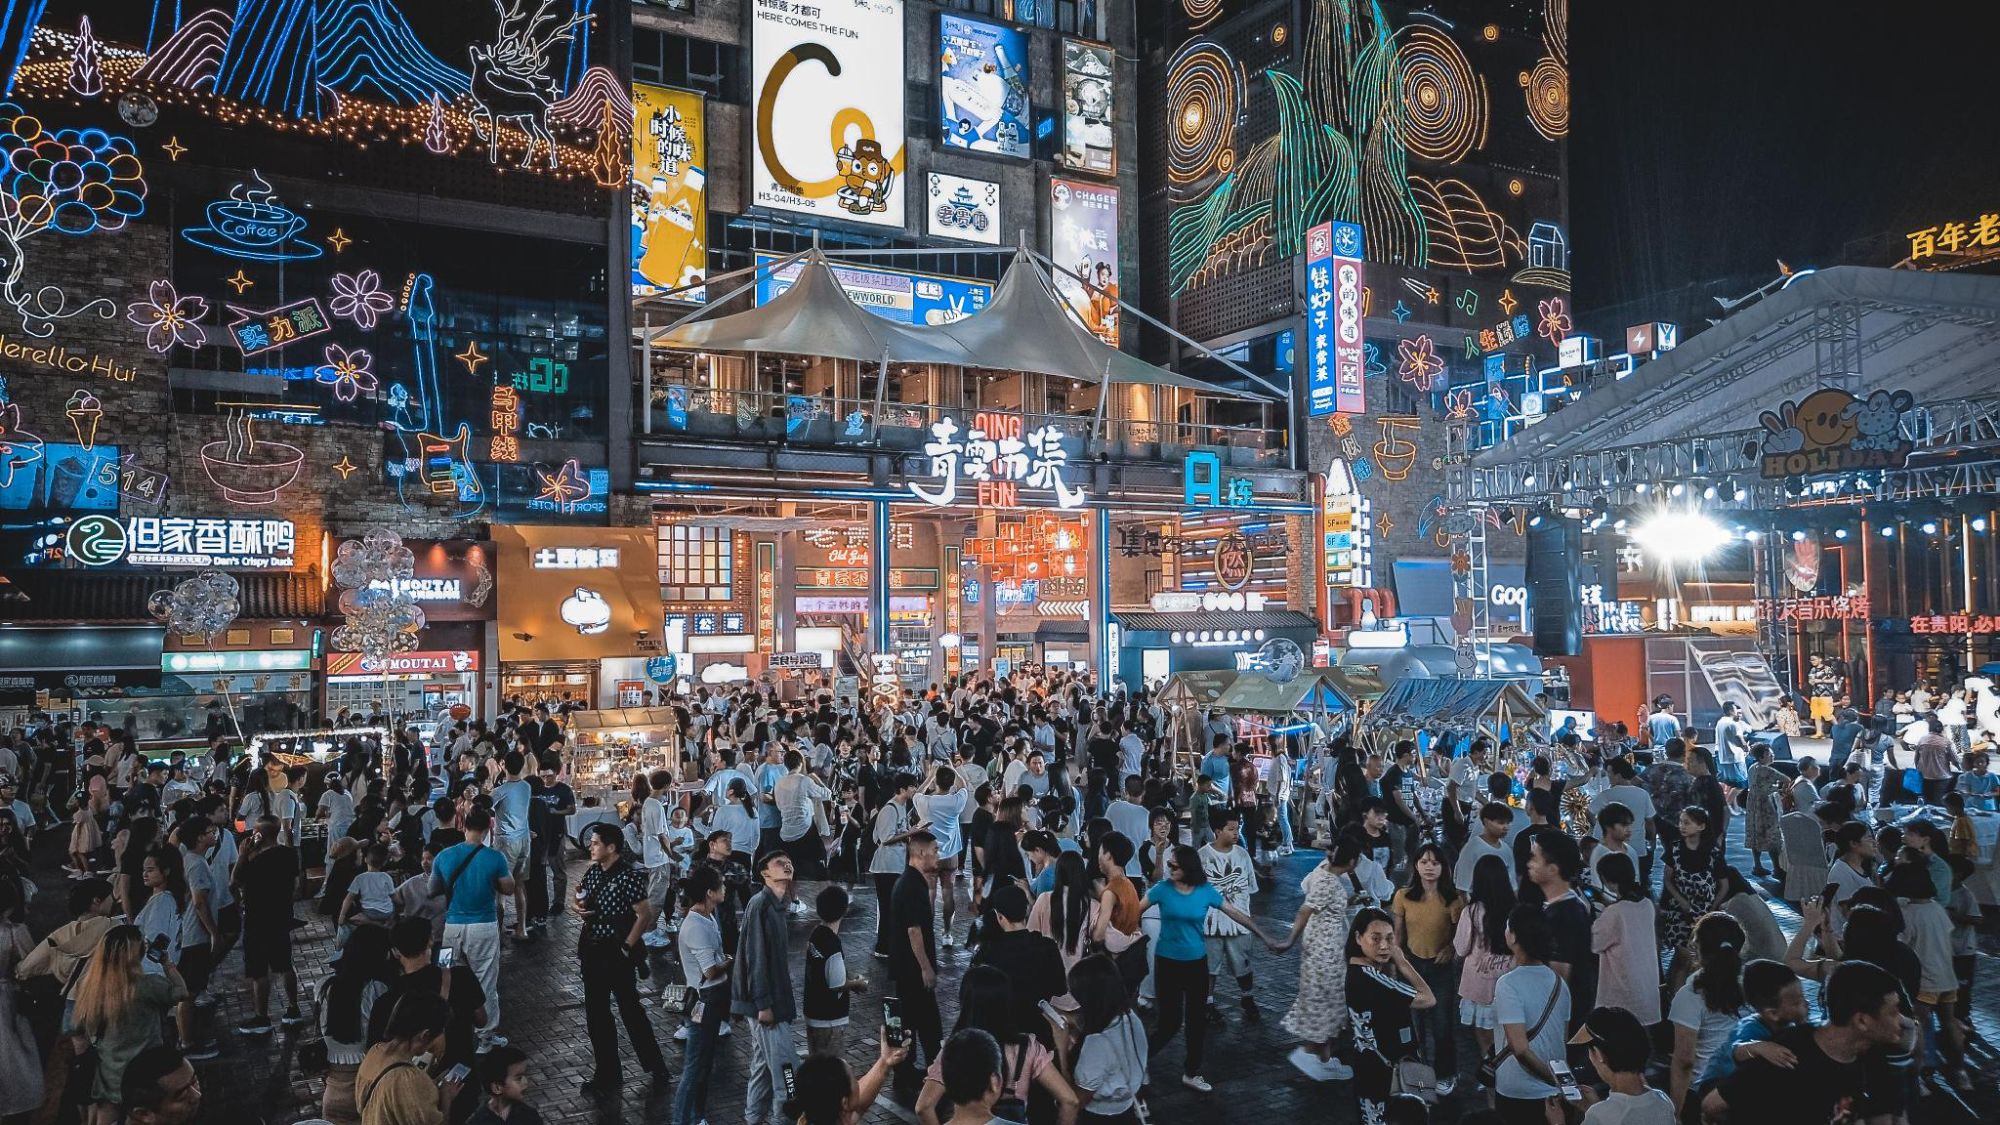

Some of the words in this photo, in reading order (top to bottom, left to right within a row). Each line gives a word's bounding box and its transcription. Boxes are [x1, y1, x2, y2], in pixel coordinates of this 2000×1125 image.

[757, 10, 783, 24] HERE
[785, 16, 818, 31] COMES
[819, 23, 838, 36] THE
[1075, 190, 1118, 205] CHAGEE
[221, 220, 279, 237] Coffee
[846, 291, 894, 305] EWWORLD
[91, 354, 137, 382] Hui
[976, 481, 1017, 508] FUN
[127, 517, 295, 555] 但家香酥鸭
[242, 556, 269, 568] Crispy
[270, 557, 294, 567] Duck
[390, 657, 447, 669] MOUTAI
